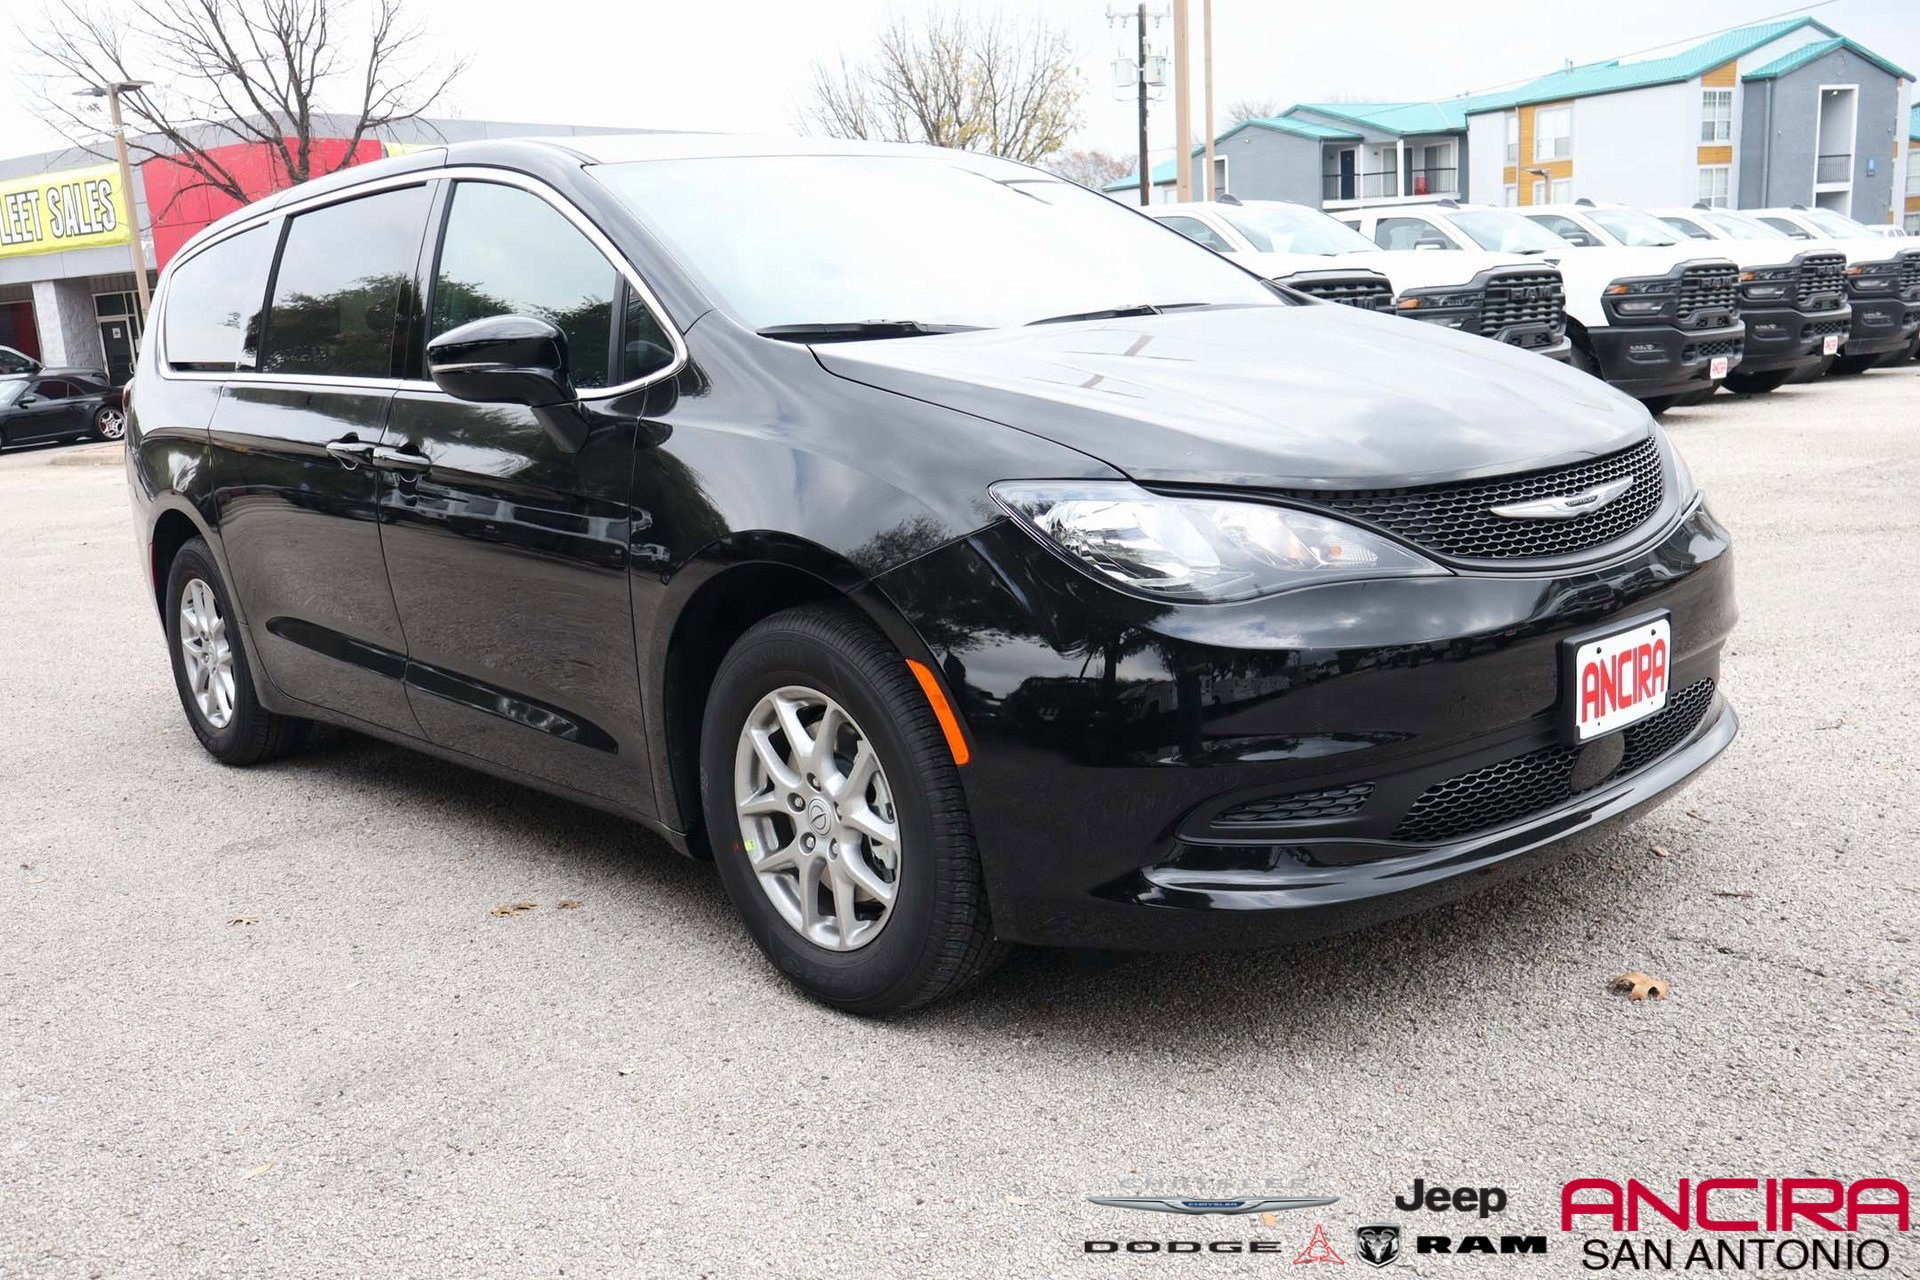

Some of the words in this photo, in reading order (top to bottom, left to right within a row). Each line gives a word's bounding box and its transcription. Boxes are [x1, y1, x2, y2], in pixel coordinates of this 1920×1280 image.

[46, 179, 116, 238] SALES
[1509, 285, 1552, 300] RAM
[1582, 639, 1665, 723] ANCIRA
